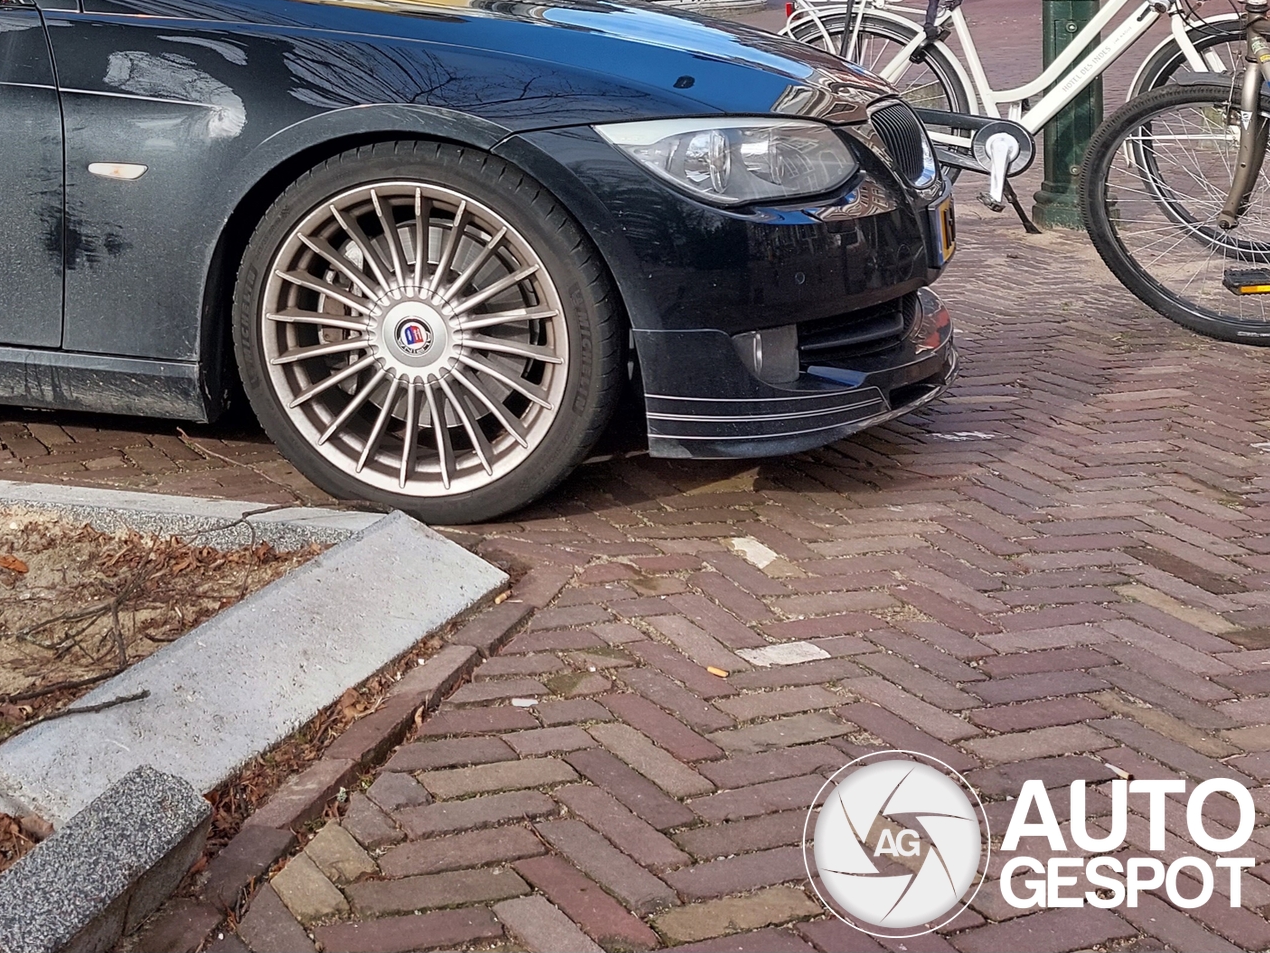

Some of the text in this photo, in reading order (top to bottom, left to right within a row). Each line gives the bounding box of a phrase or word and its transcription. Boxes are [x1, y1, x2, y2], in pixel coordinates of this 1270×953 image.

[1062, 74, 1082, 92] HOTEL
[1081, 63, 1093, 75] DES
[1092, 46, 1112, 64] INDES
[240, 268, 257, 364] MICHELIN
[574, 311, 592, 414] MICHELIN
